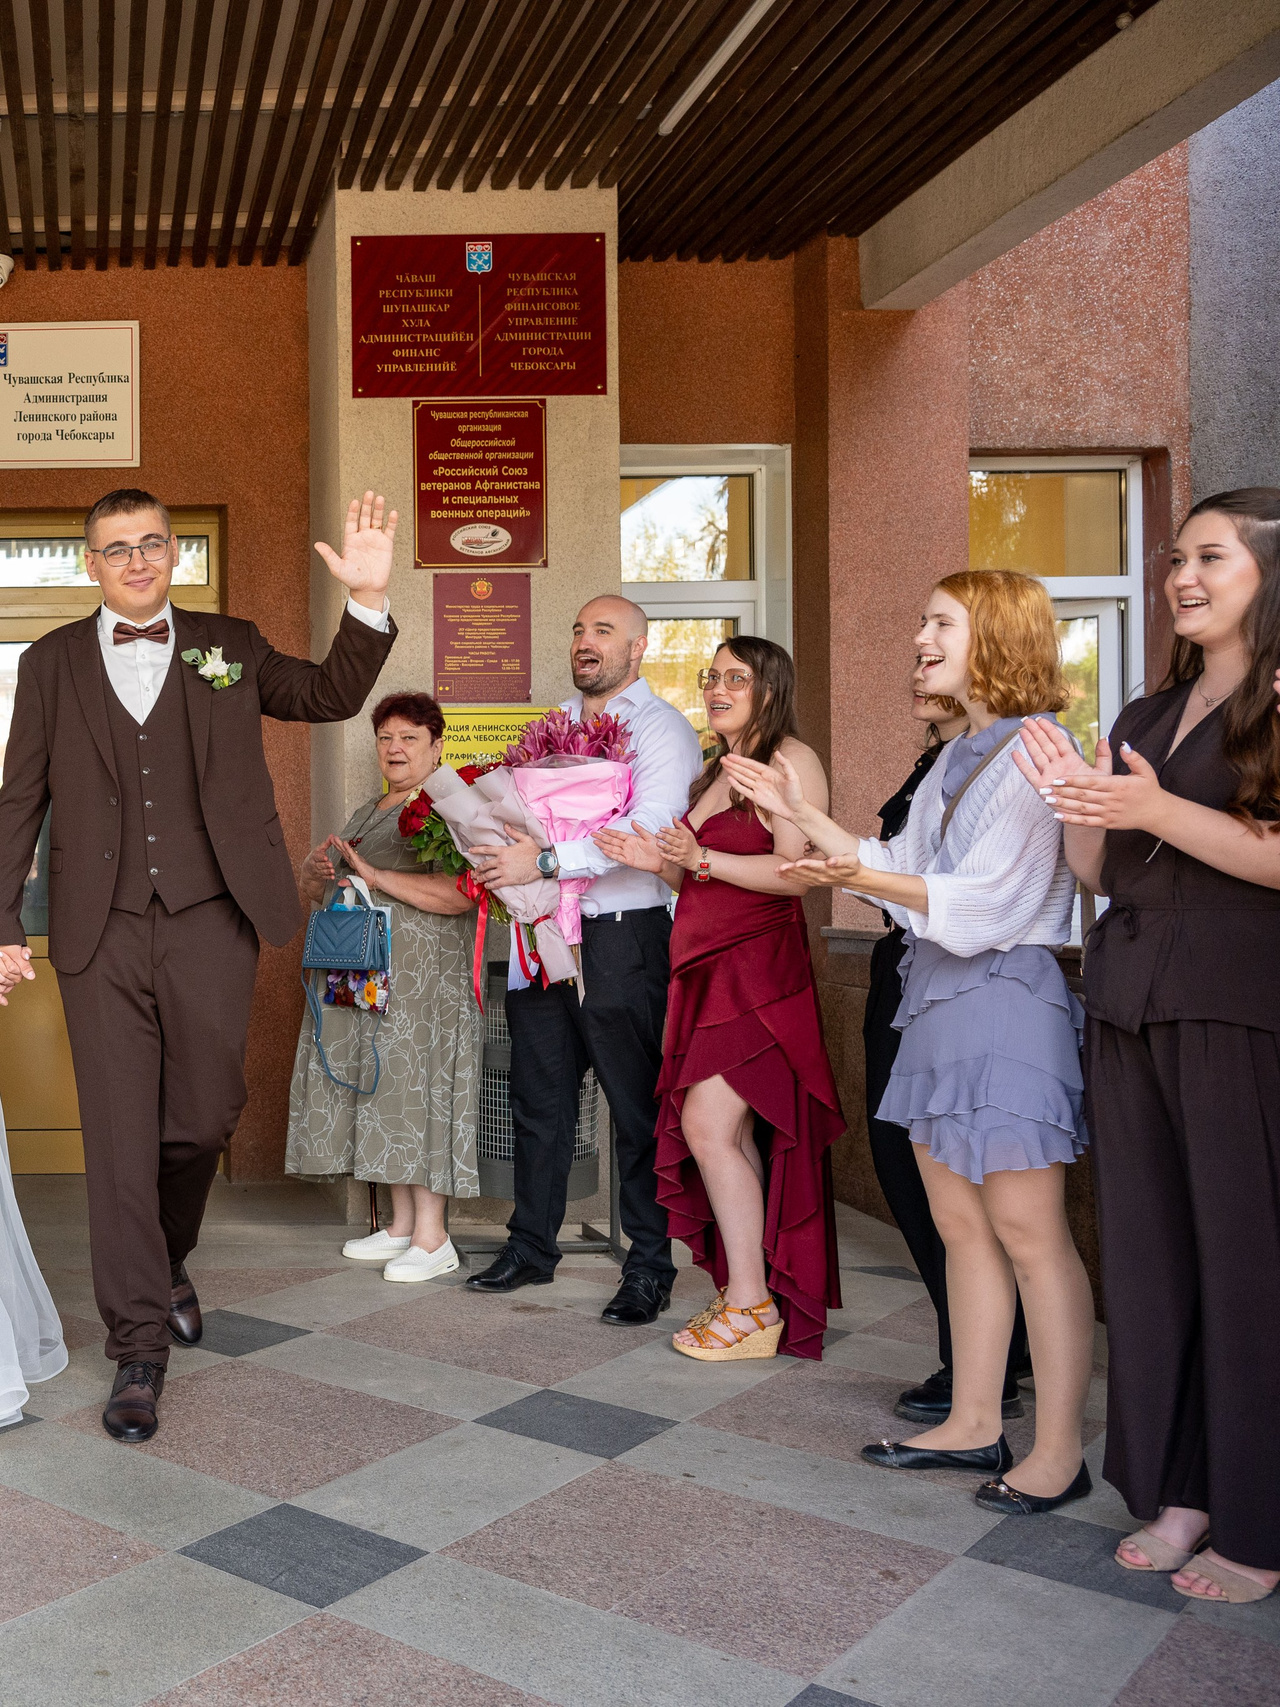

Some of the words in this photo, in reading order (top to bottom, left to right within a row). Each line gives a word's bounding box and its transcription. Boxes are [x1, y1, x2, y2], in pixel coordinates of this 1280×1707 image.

[508, 273, 576, 281] ЧУВАШСКАЯ
[379, 289, 453, 298] РЕСПУБЛИКИ
[507, 288, 578, 296] РЕСПУБЛИКА
[383, 304, 450, 313] ШУПАШКАР
[505, 302, 581, 311] ФИНАНСОВОЕ
[402, 319, 430, 327] ХУЛА
[508, 317, 578, 326] УПРАВЛЕНИЕ
[495, 332, 591, 341] АДМИНИСТРАЦИИ
[393, 349, 440, 357] ФИНАНС
[522, 347, 564, 356] ГОРОДА
[510, 362, 576, 370] ЧЕБОКСАРЫ
[3, 373, 63, 386] Чувашская
[68, 372, 129, 384] Республика
[23, 393, 108, 405] Администрация
[14, 411, 76, 422] Ленинского
[80, 411, 117, 423] района
[431, 411, 468, 421] Чувашская
[470, 409, 528, 420] республиканская
[458, 425, 501, 433] организация
[17, 432, 52, 443] города
[56, 429, 114, 442] Чебоксары
[451, 438, 515, 448] Общероссийской
[429, 451, 483, 460] общественной
[485, 451, 533, 461] организации
[433, 466, 498, 476] «Российский
[502, 466, 528, 475] Союз
[421, 482, 471, 492] ветеранов
[475, 480, 540, 491] Афганистана
[452, 496, 518, 504] специальных
[476, 508, 530, 519] операций»
